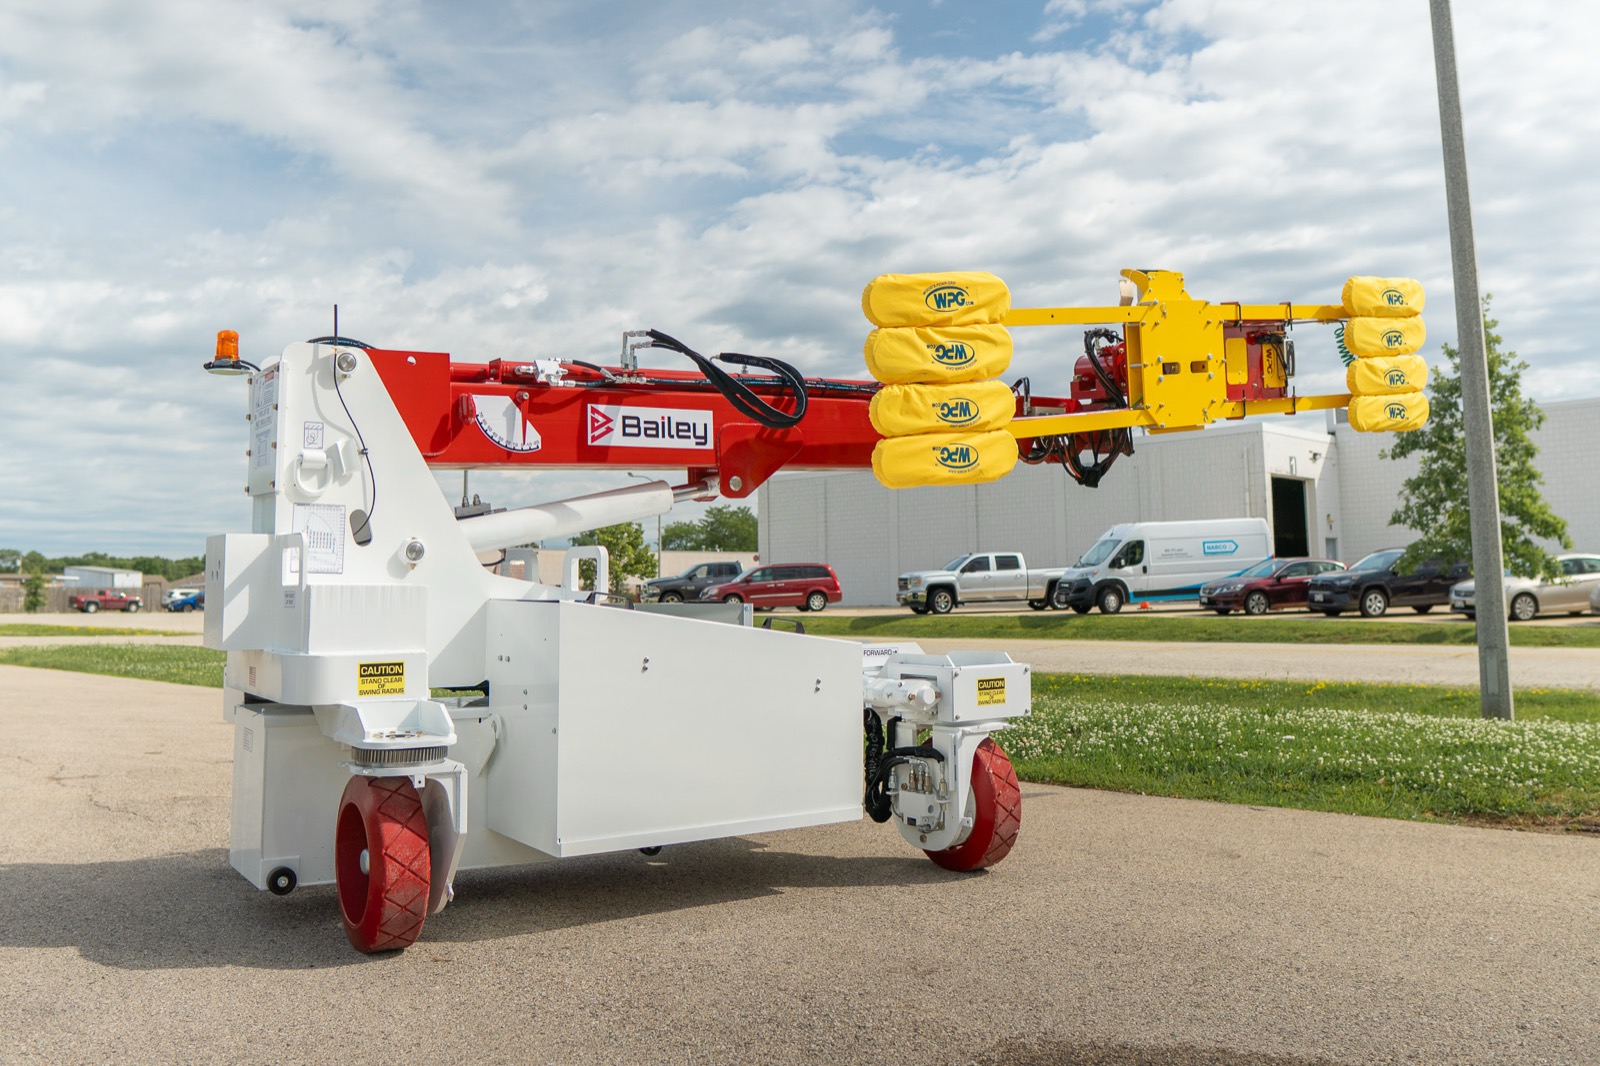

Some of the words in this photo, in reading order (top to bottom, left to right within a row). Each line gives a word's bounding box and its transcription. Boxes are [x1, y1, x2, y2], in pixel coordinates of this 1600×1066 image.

[934, 291, 965, 309] WPG
[1386, 294, 1404, 305] WPG
[1386, 335, 1402, 346] WPG
[935, 344, 967, 360] WPG
[1389, 374, 1405, 385] WPG
[940, 402, 971, 418] WPG
[1389, 407, 1405, 419] WPG
[622, 415, 708, 445] Bailey
[940, 447, 970, 463] WPG
[361, 665, 402, 675] CAUTION
[979, 680, 1004, 688] CAUTION
